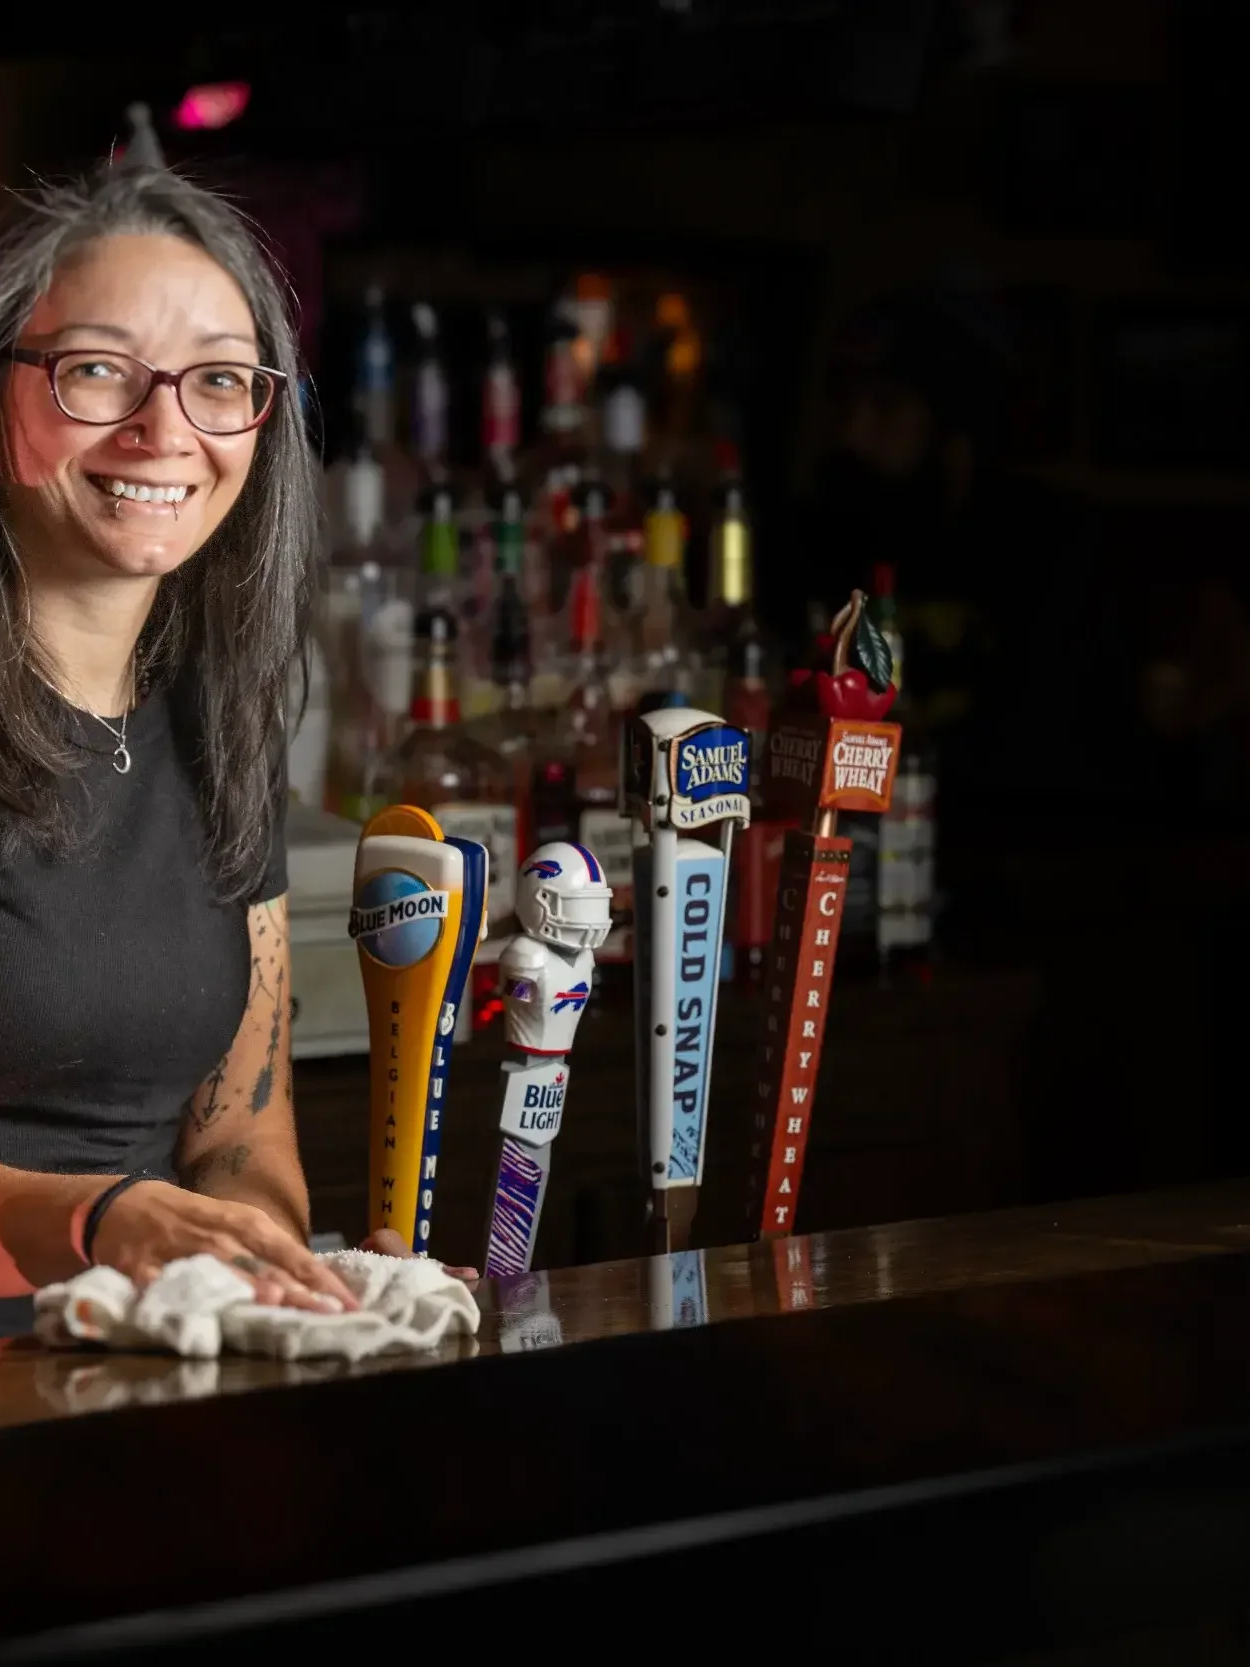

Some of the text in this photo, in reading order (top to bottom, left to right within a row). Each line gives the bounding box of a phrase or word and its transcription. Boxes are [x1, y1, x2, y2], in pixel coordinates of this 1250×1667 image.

[681, 740, 746, 772] SAMUEL
[833, 741, 893, 770] CHERRY
[685, 763, 744, 792] ADAMS
[835, 764, 886, 797] WHEAT
[679, 799, 744, 824] SEASONAL
[349, 908, 386, 938] BLUE
[673, 872, 712, 1114] COLD SNAP
[798, 890, 838, 1070] CHERRY
[385, 1001, 400, 1150] BELGIAN
[431, 1002, 455, 1131] BLUE
[523, 1084, 564, 1109] Blue
[519, 1110, 560, 1130] LIGHT
[774, 1086, 810, 1226] WHEAT
